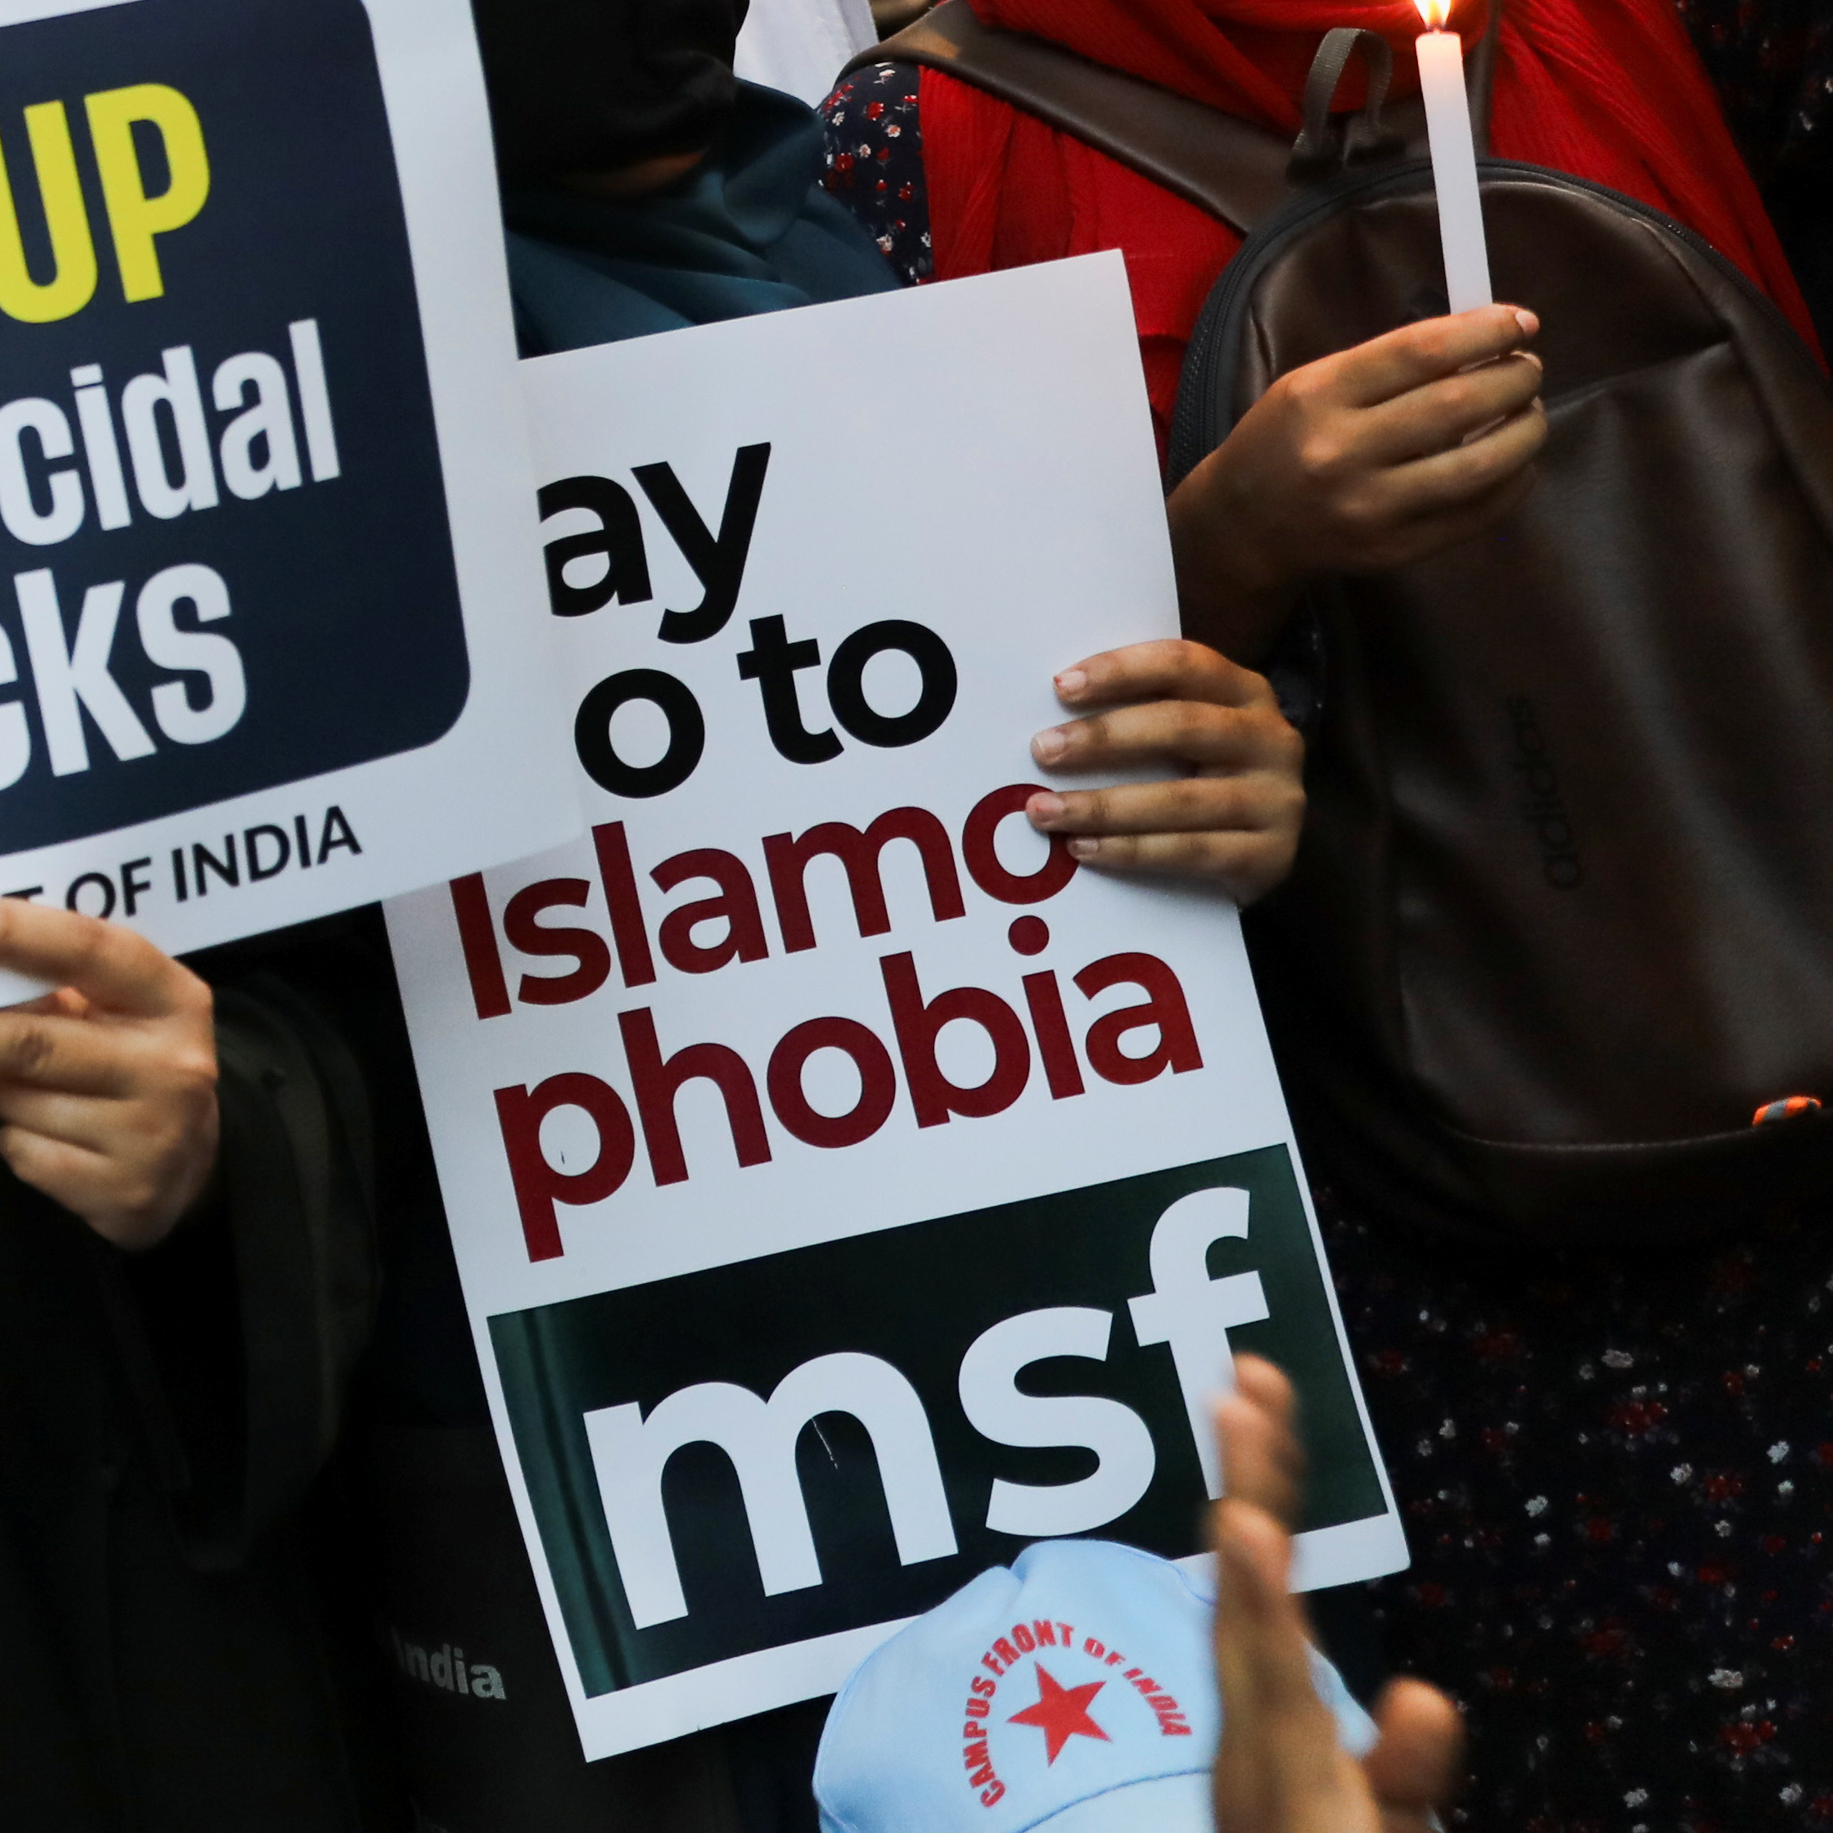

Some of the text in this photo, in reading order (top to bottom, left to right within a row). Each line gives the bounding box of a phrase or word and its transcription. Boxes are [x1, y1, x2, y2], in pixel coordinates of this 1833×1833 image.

[737, 613, 958, 766] to
[66, 856, 153, 923] OF
[170, 803, 364, 903] INDIA
[1506, 695, 1583, 890] adidas
[447, 783, 1081, 1021] Islamo
[493, 914, 1204, 1264] phobia
[583, 1186, 1271, 1631] msf
[963, 1619, 1193, 1808] CAMPUS FRONT OF INDIA
